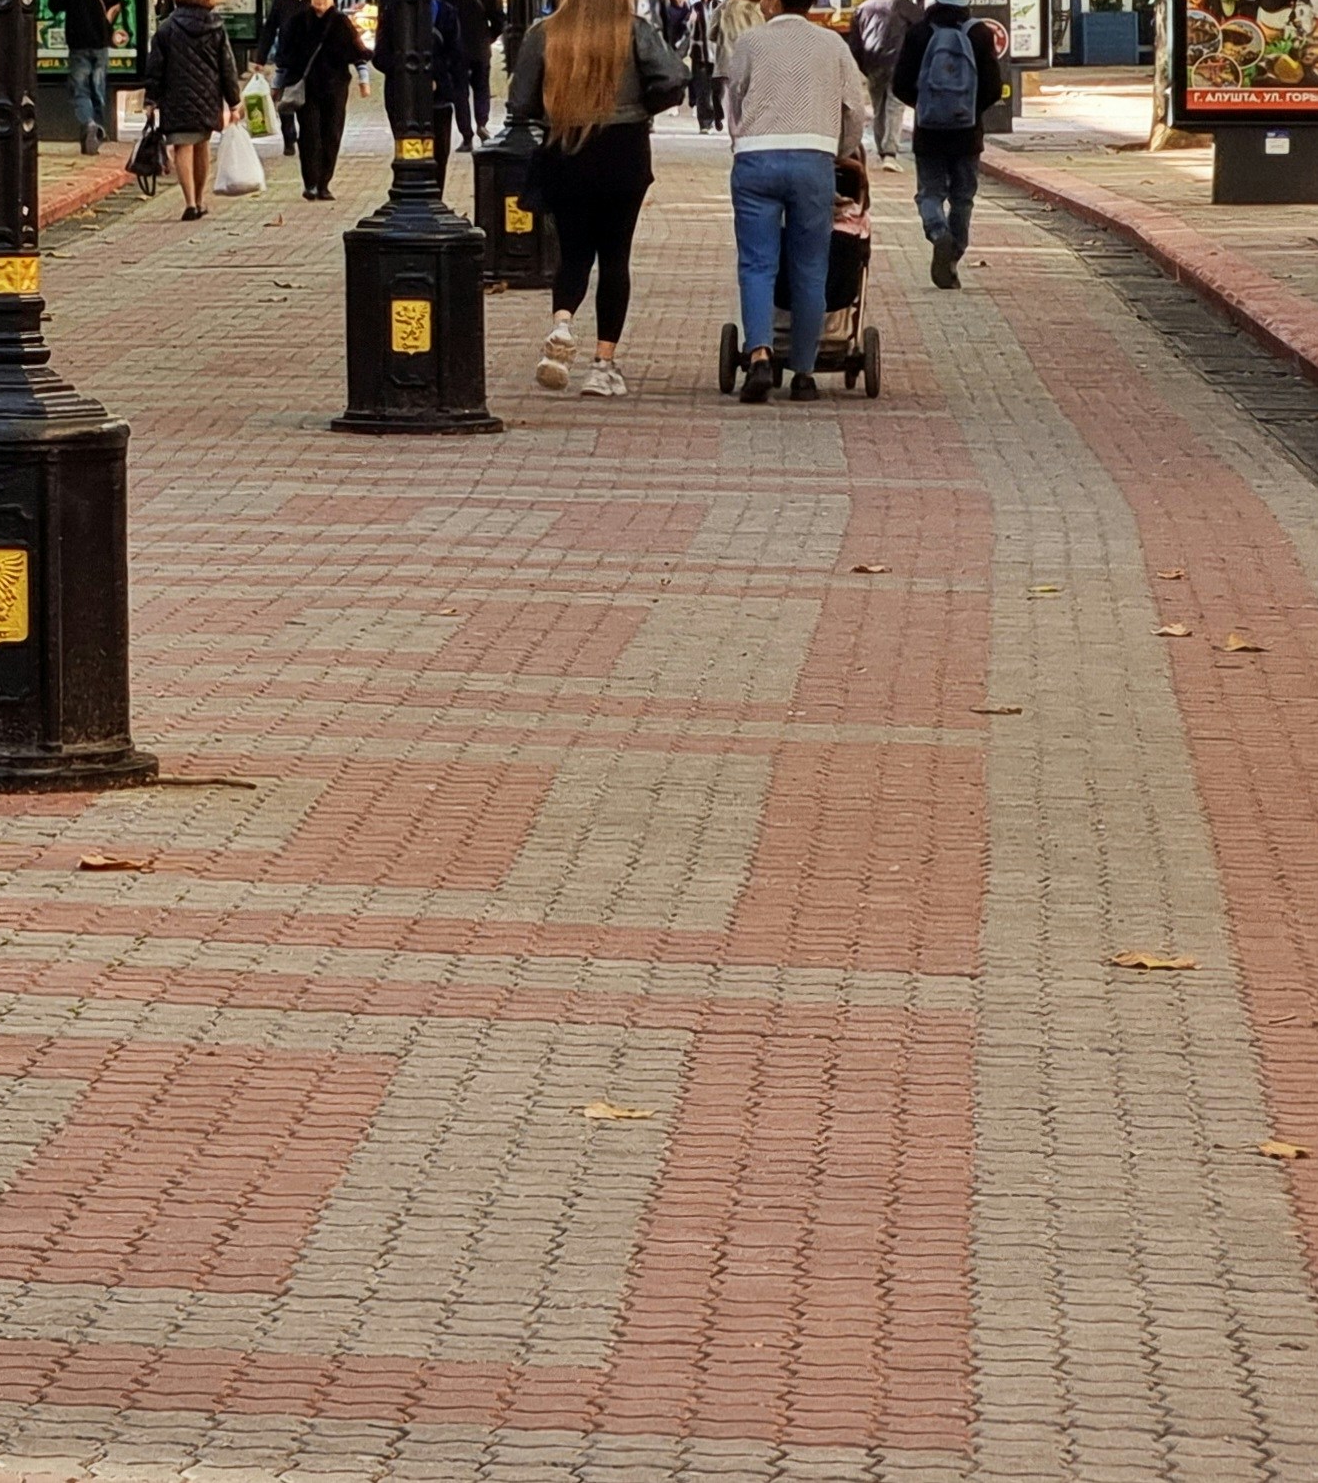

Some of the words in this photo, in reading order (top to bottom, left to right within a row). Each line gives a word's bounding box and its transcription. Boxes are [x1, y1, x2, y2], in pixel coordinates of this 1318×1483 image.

[1193, 93, 1203, 103] Г.
[1205, 93, 1261, 103] АЛУШТА,
[1263, 93, 1284, 102] УЛ.
